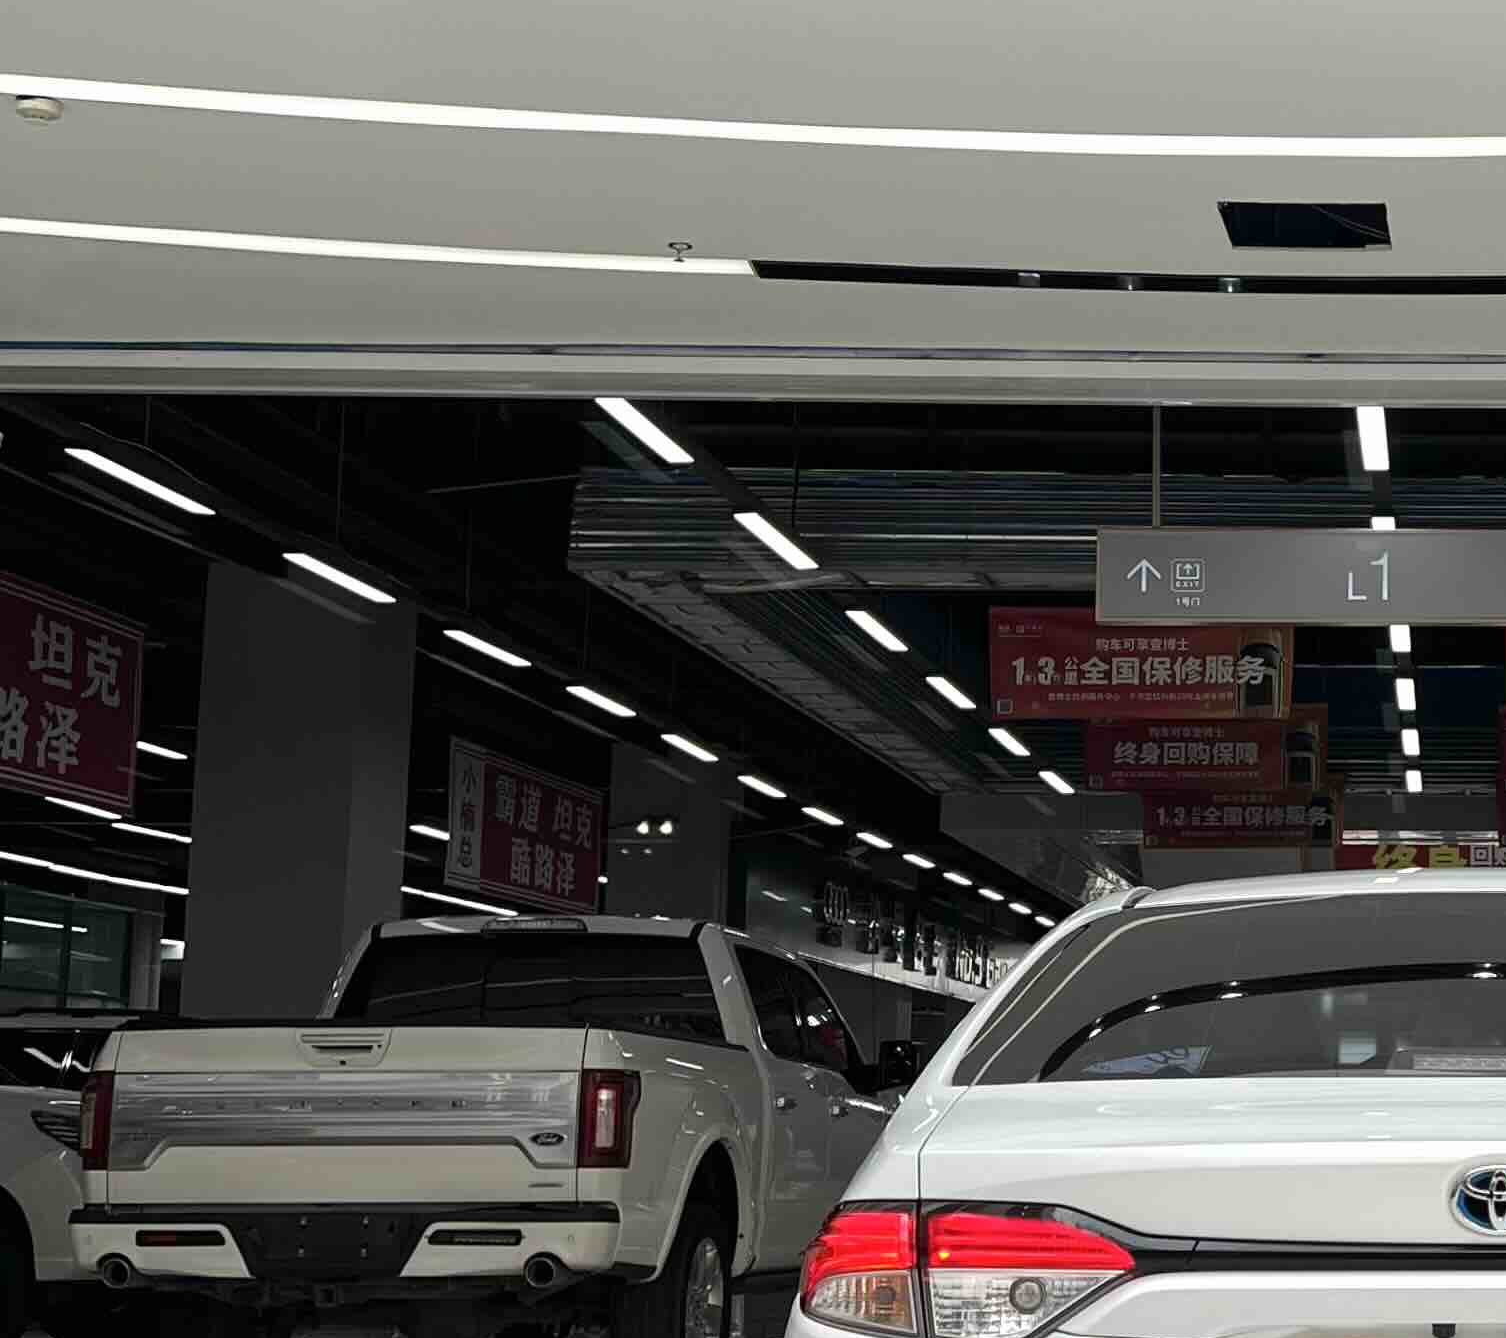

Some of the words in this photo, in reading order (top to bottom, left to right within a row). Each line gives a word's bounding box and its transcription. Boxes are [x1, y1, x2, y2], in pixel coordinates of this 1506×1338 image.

[1346, 550, 1390, 602] L1
[28, 613, 122, 709] 坦克
[1113, 741, 1259, 766] 终身回购保障
